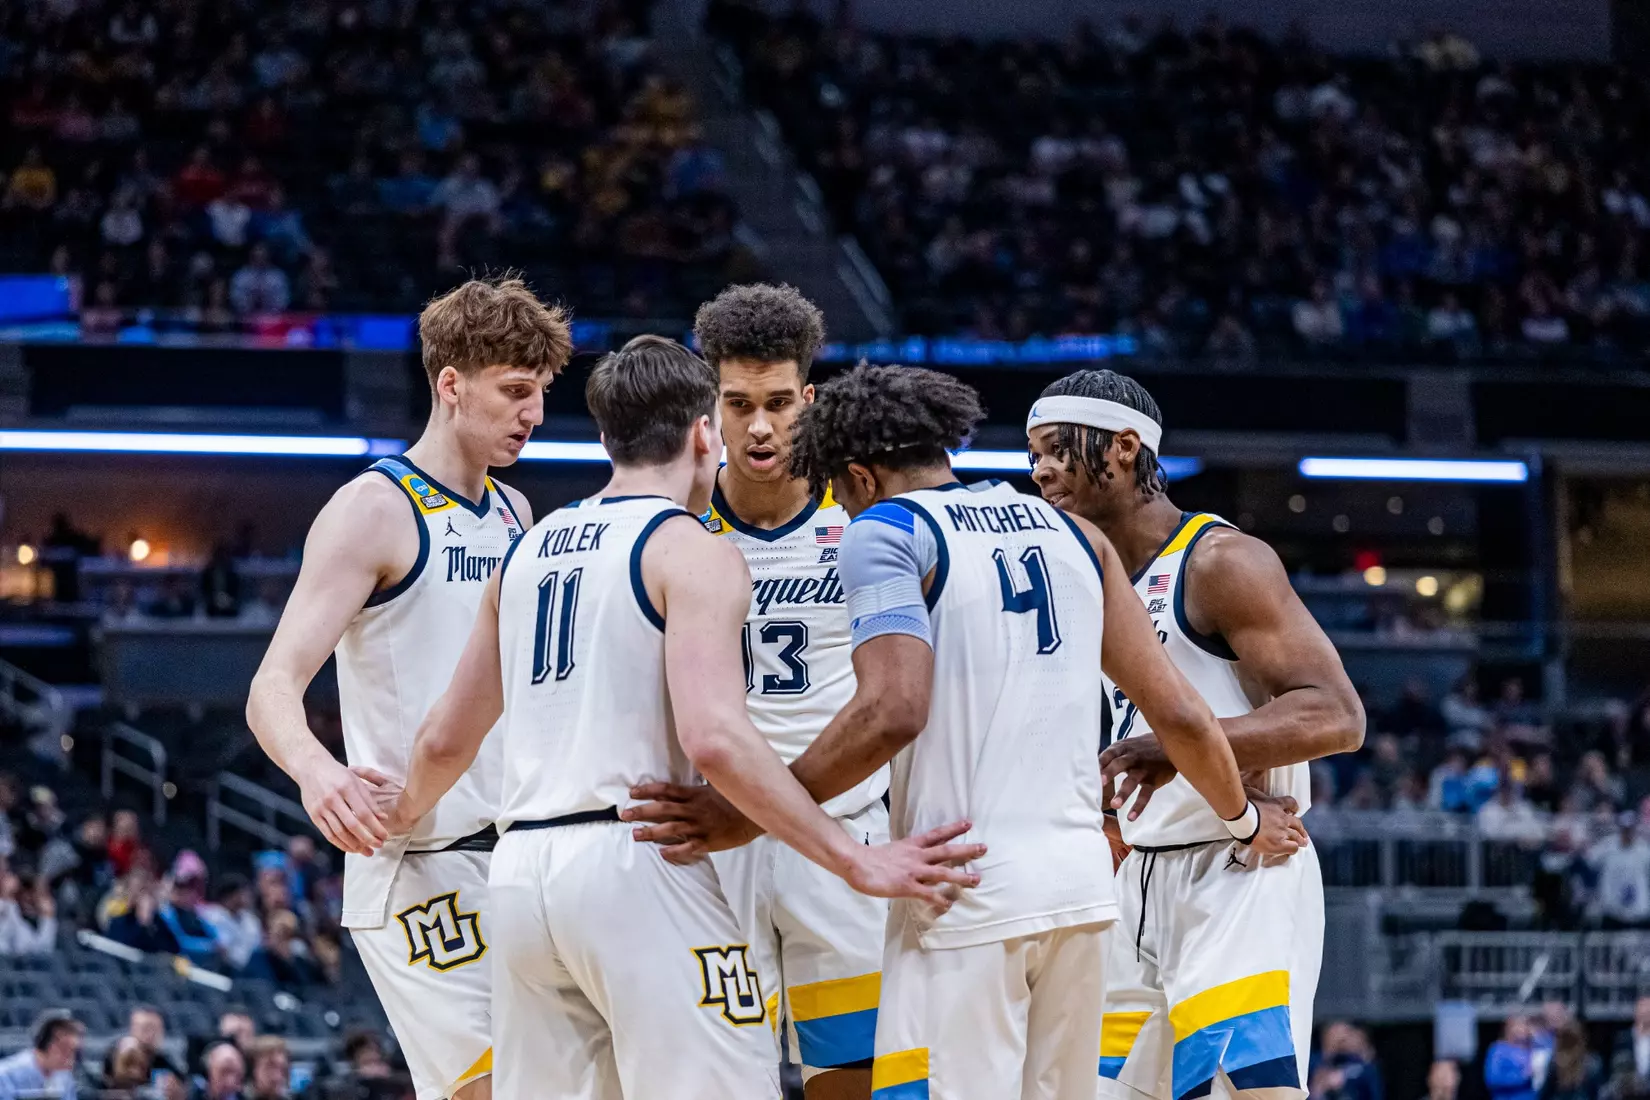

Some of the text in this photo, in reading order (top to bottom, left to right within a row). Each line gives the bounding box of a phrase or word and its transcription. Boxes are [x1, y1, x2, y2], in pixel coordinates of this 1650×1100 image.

[537, 522, 611, 559] KOLEK
[944, 503, 1060, 534] MITCHELL
[441, 546, 502, 582] Marq
[991, 545, 1062, 656] 4
[531, 566, 584, 685] 11
[395, 889, 488, 973] MU
[690, 943, 766, 1027] MU
